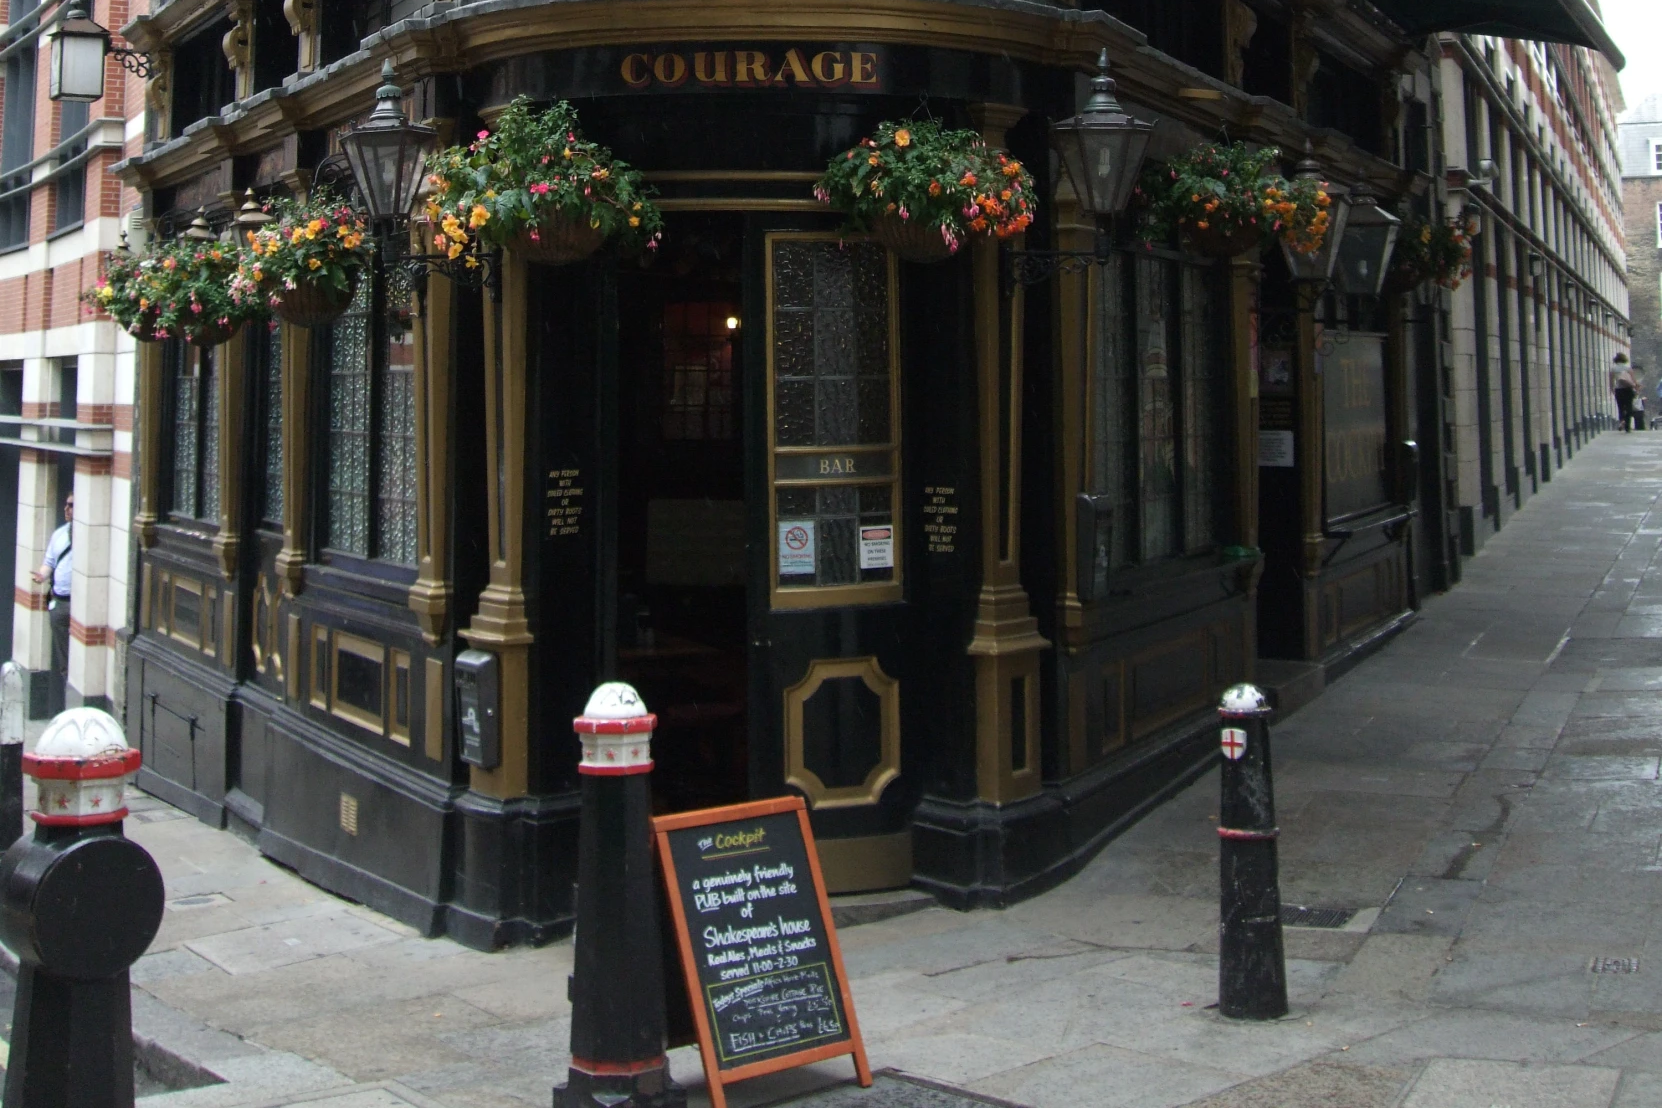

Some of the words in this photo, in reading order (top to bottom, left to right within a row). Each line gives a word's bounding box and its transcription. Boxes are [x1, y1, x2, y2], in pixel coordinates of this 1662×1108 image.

[621, 48, 882, 87] COURAGE
[1339, 358, 1371, 409] THE
[820, 458, 856, 474] BAR
[714, 828, 767, 849] Cockpit
[692, 879, 701, 891] a
[702, 869, 752, 893] genuinely
[753, 862, 794, 883] friendly
[694, 892, 722, 911] PUB
[721, 887, 746, 905] built
[777, 880, 798, 895] site
[740, 902, 754, 919] of
[703, 922, 779, 948] Shakespeare's
[777, 915, 812, 936] house
[707, 952, 726, 967] Real
[783, 936, 818, 953] Snacks
[719, 963, 751, 981] served
[730, 1032, 757, 1050] FISH
